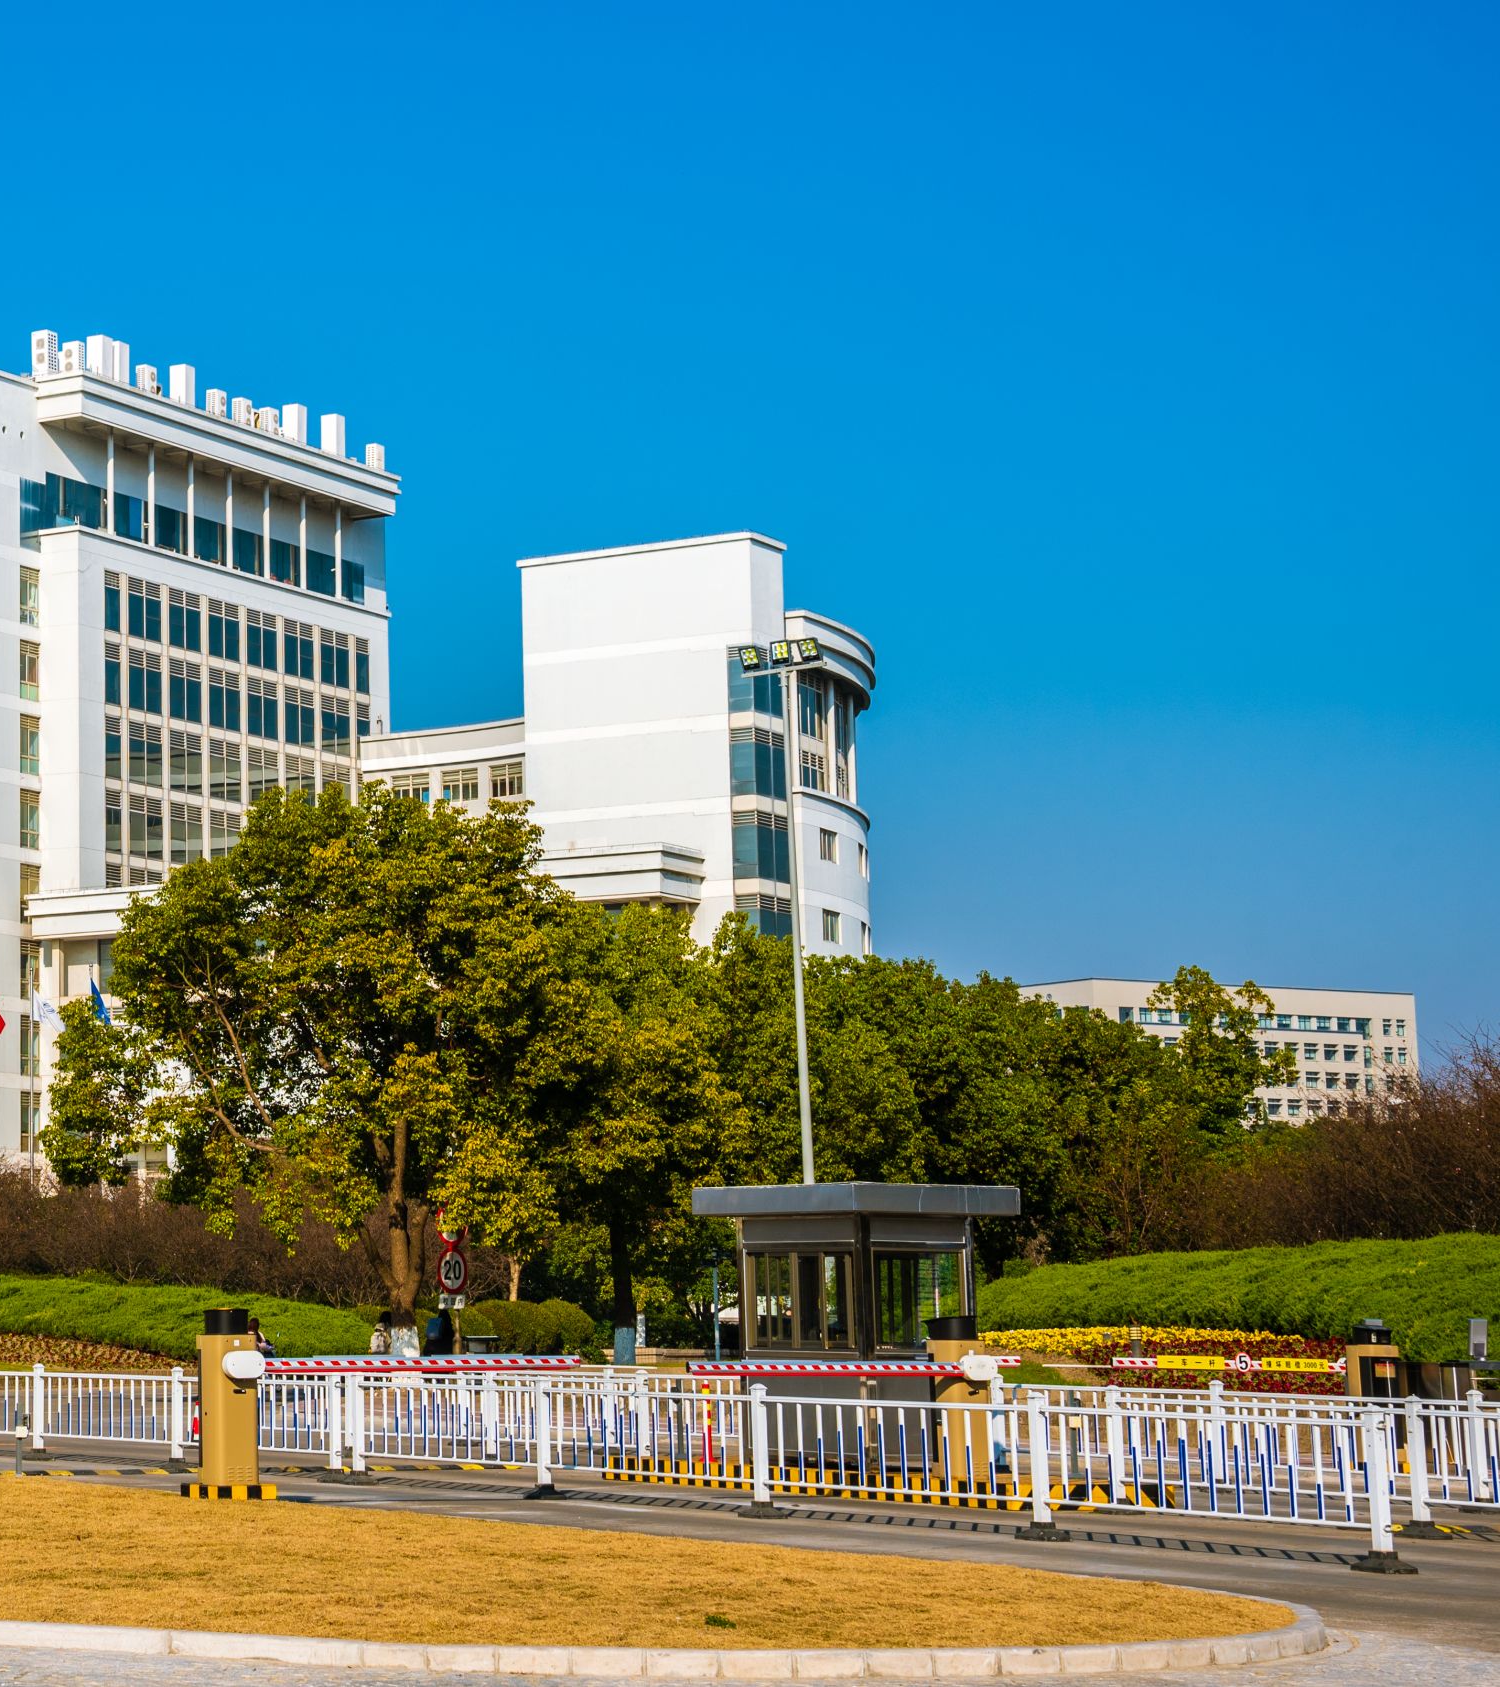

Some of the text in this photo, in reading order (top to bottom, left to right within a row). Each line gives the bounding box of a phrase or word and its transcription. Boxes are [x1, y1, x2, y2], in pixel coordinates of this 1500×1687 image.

[443, 1260, 462, 1281] 20
[1166, 1358, 1215, 1368] 一车一杆
[1238, 1355, 1249, 1371] 5
